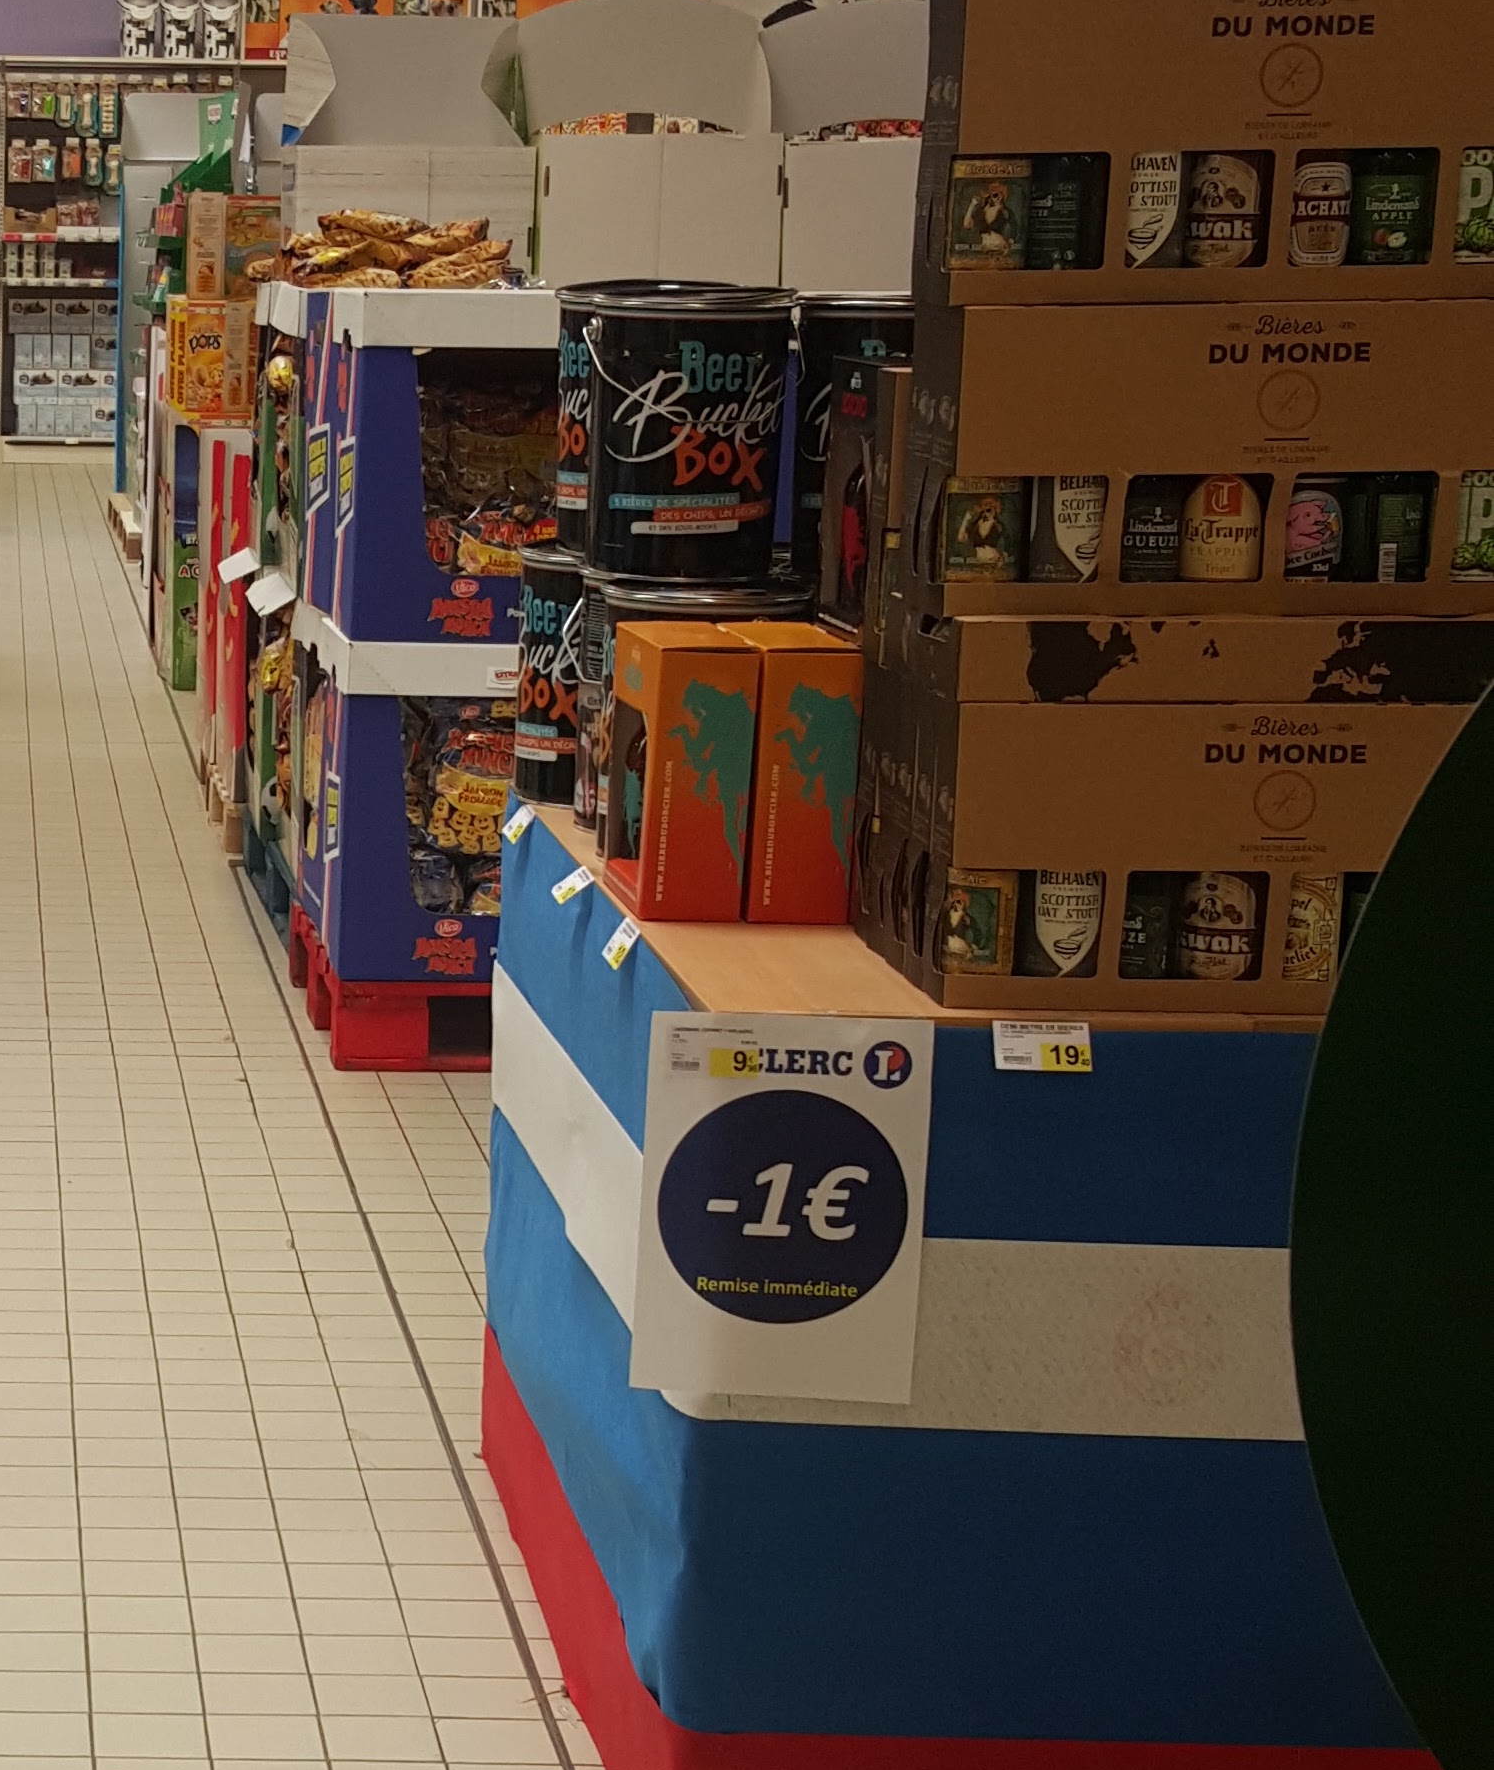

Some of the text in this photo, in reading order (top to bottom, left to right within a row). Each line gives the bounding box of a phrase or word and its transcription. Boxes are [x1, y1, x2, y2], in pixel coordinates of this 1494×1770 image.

[1211, 14, 1375, 38] DU MONDE
[1372, 211, 1413, 221] APPLE
[1254, 314, 1325, 336] Bières
[1208, 342, 1372, 365] DU MONDE
[679, 339, 759, 394] Beer
[1251, 716, 1322, 738] Bières
[1205, 744, 1367, 764] DU MONDE
[1040, 869, 1100, 886] BELHAVEN
[705, 1161, 871, 1242] -1€
[696, 1276, 859, 1299] Remise immédiate
